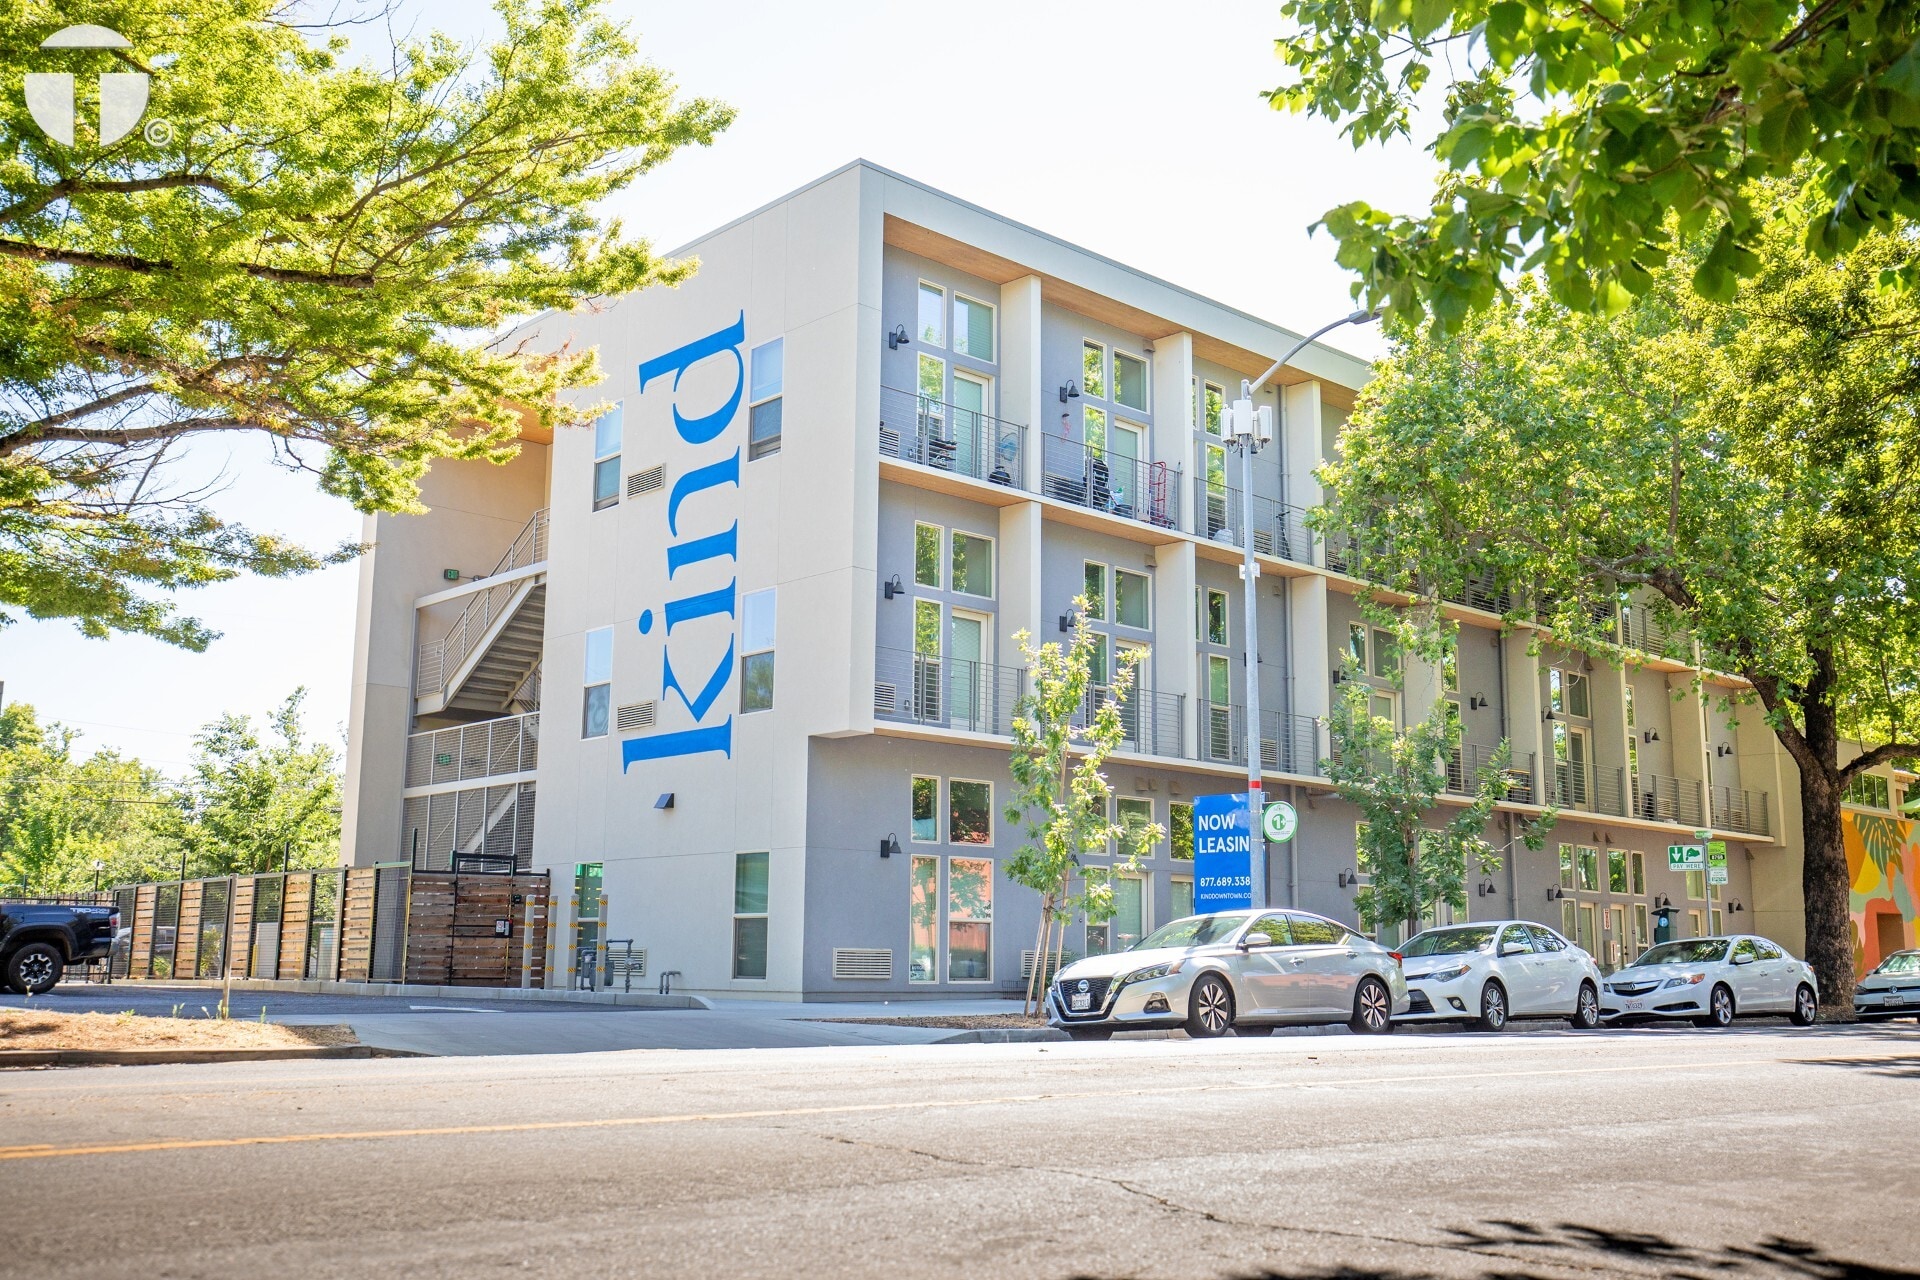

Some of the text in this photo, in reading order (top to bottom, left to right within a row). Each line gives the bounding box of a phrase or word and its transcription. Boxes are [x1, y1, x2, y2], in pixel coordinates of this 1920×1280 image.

[622, 309, 745, 774] kind
[1198, 814, 1236, 831] NOW
[1199, 836, 1250, 854] LEASIN
[1200, 876, 1251, 887] 877.689.338
[1200, 892, 1252, 900] KINDDOWNTOWN.CO
